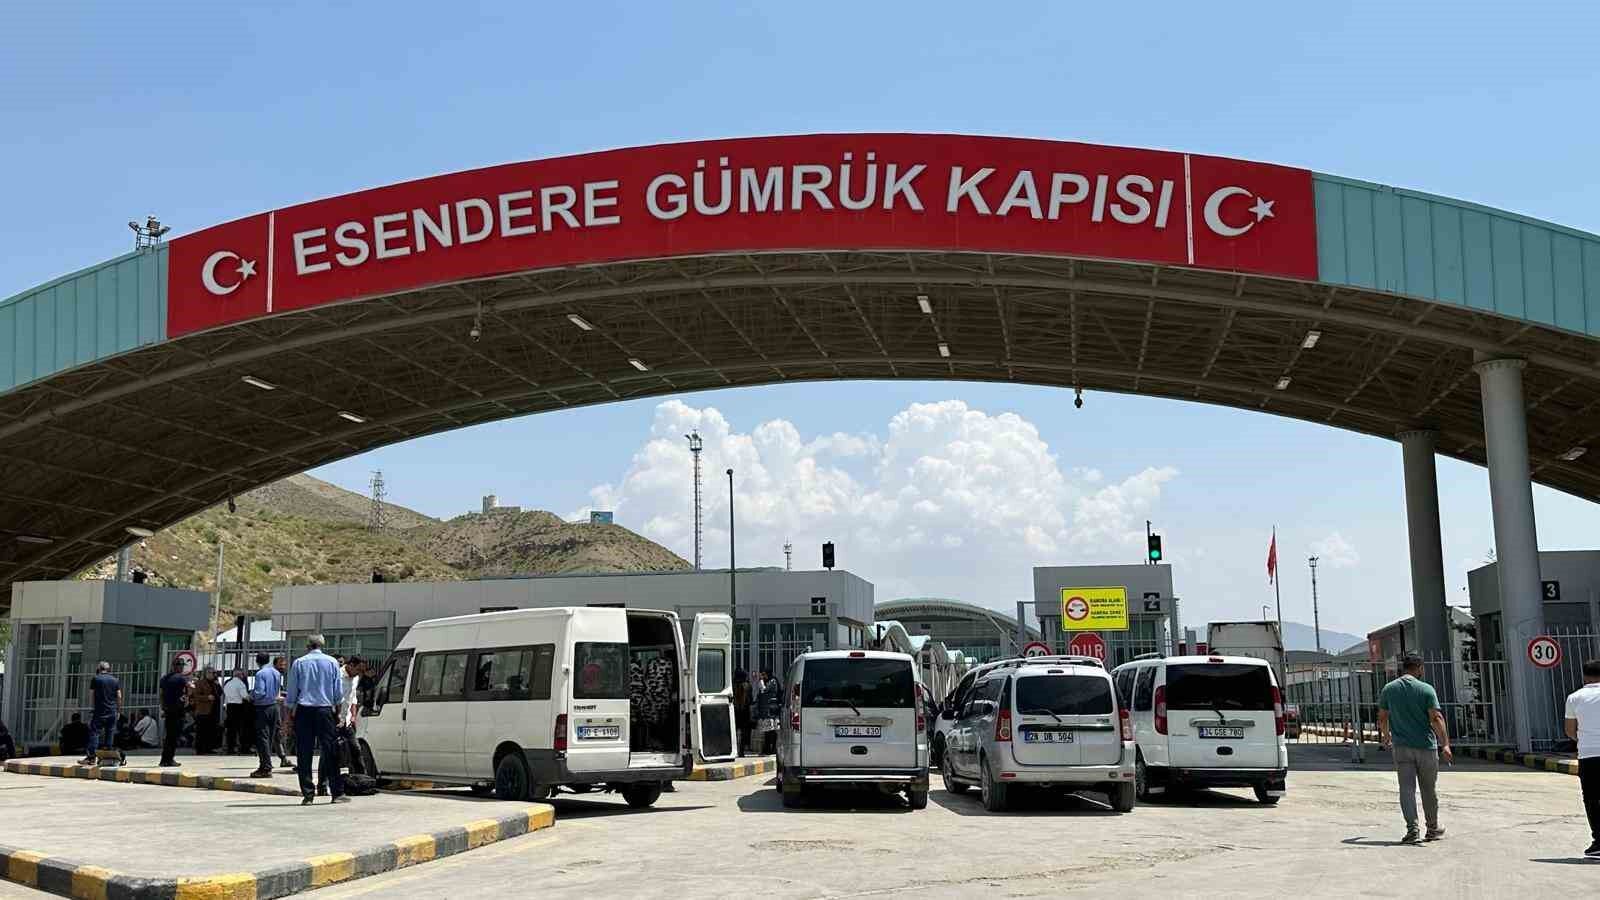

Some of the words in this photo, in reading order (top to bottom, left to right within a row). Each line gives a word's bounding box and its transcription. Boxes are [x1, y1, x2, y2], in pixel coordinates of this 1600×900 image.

[292, 180, 621, 275] ESENDERE
[645, 151, 927, 221] GÜMRÜK
[946, 166, 1176, 228] KAPISI
[1546, 583, 1556, 598] 3
[1148, 594, 1157, 608] 2
[1072, 644, 1103, 658] DUR
[1534, 645, 1555, 659] 30
